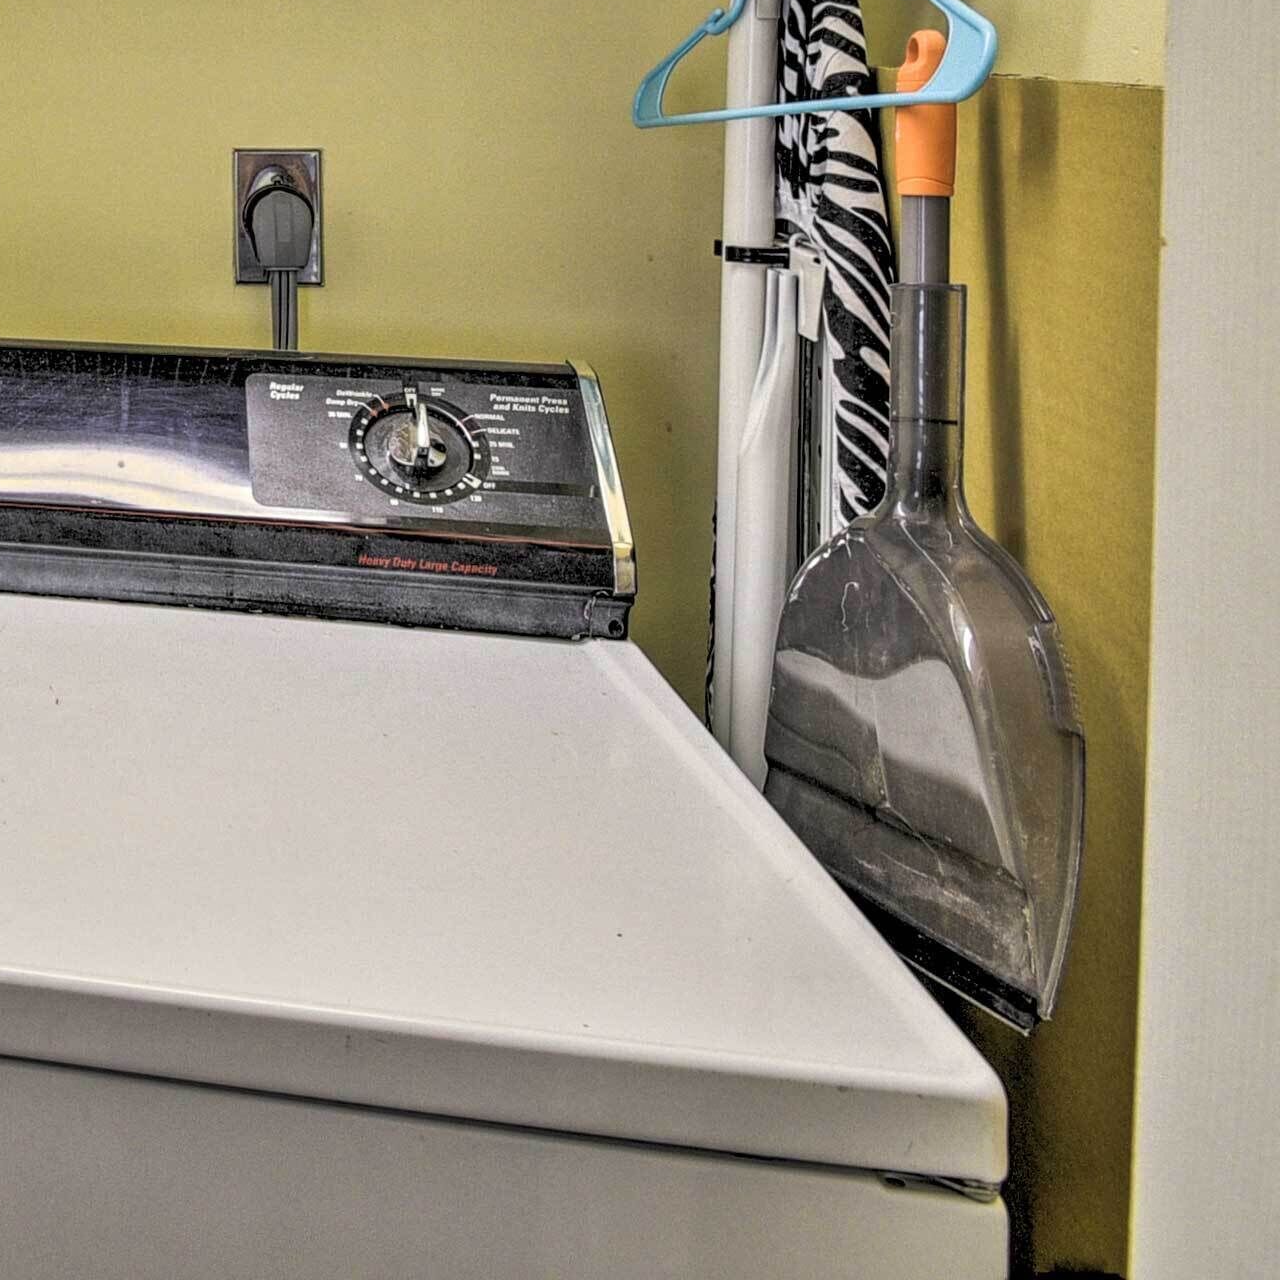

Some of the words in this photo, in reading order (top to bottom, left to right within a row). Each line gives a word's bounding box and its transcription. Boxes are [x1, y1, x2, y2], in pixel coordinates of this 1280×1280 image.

[269, 381, 304, 392] Regular
[270, 390, 300, 400] Cycles
[490, 393, 540, 404] Permanent
[541, 395, 568, 405] Press
[326, 398, 345, 406] Damp
[347, 398, 360, 407] Dry
[493, 403, 510, 411] and
[512, 403, 536, 412] Knits
[538, 404, 570, 414] Cycles
[474, 413, 505, 421] NORMAL
[487, 427, 520, 435] DELICATE
[358, 554, 391, 568] Heavy
[392, 556, 417, 569] Duty
[419, 558, 449, 572] Large
[451, 560, 498, 576] Capacity
